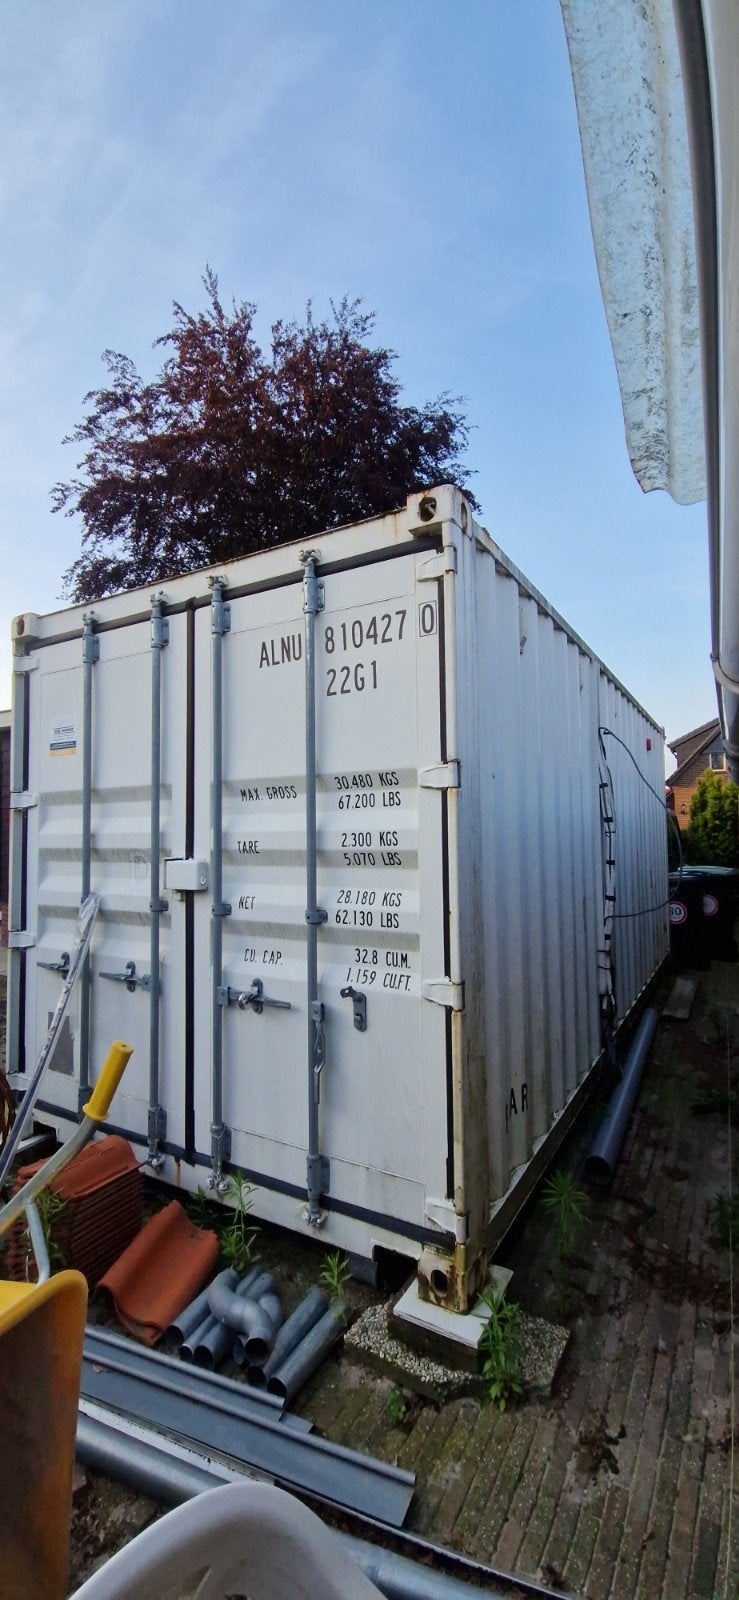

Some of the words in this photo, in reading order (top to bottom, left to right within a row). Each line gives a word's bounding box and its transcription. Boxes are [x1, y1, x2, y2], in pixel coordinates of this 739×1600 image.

[259, 633, 302, 668] ALNU
[324, 609, 407, 654] 810427
[421, 603, 435, 634] 0
[326, 660, 377, 697] 22G1
[334, 774, 373, 790] 30.480
[378, 771, 400, 787] KGS
[240, 787, 264, 802] MAX.
[266, 785, 297, 800] GROSS
[338, 794, 376, 809] 67.200
[382, 792, 401, 807] LBS
[237, 841, 260, 854] TARE
[341, 832, 372, 847] 2.300
[379, 831, 399, 847] KGS
[343, 852, 376, 866] 5.070
[382, 852, 402, 866] LBS
[238, 896, 256, 910] NET
[336, 889, 376, 906] 28.180
[382, 892, 402, 907] KGS
[335, 910, 373, 927] 62.130
[380, 912, 400, 929] LBS
[244, 949, 258, 963] CU.
[262, 950, 283, 966] CAP.
[354, 948, 378, 965] 32.8
[385, 951, 411, 969] CU.M.
[346, 967, 377, 985] 1.159
[383, 972, 411, 992] CU.FT.
